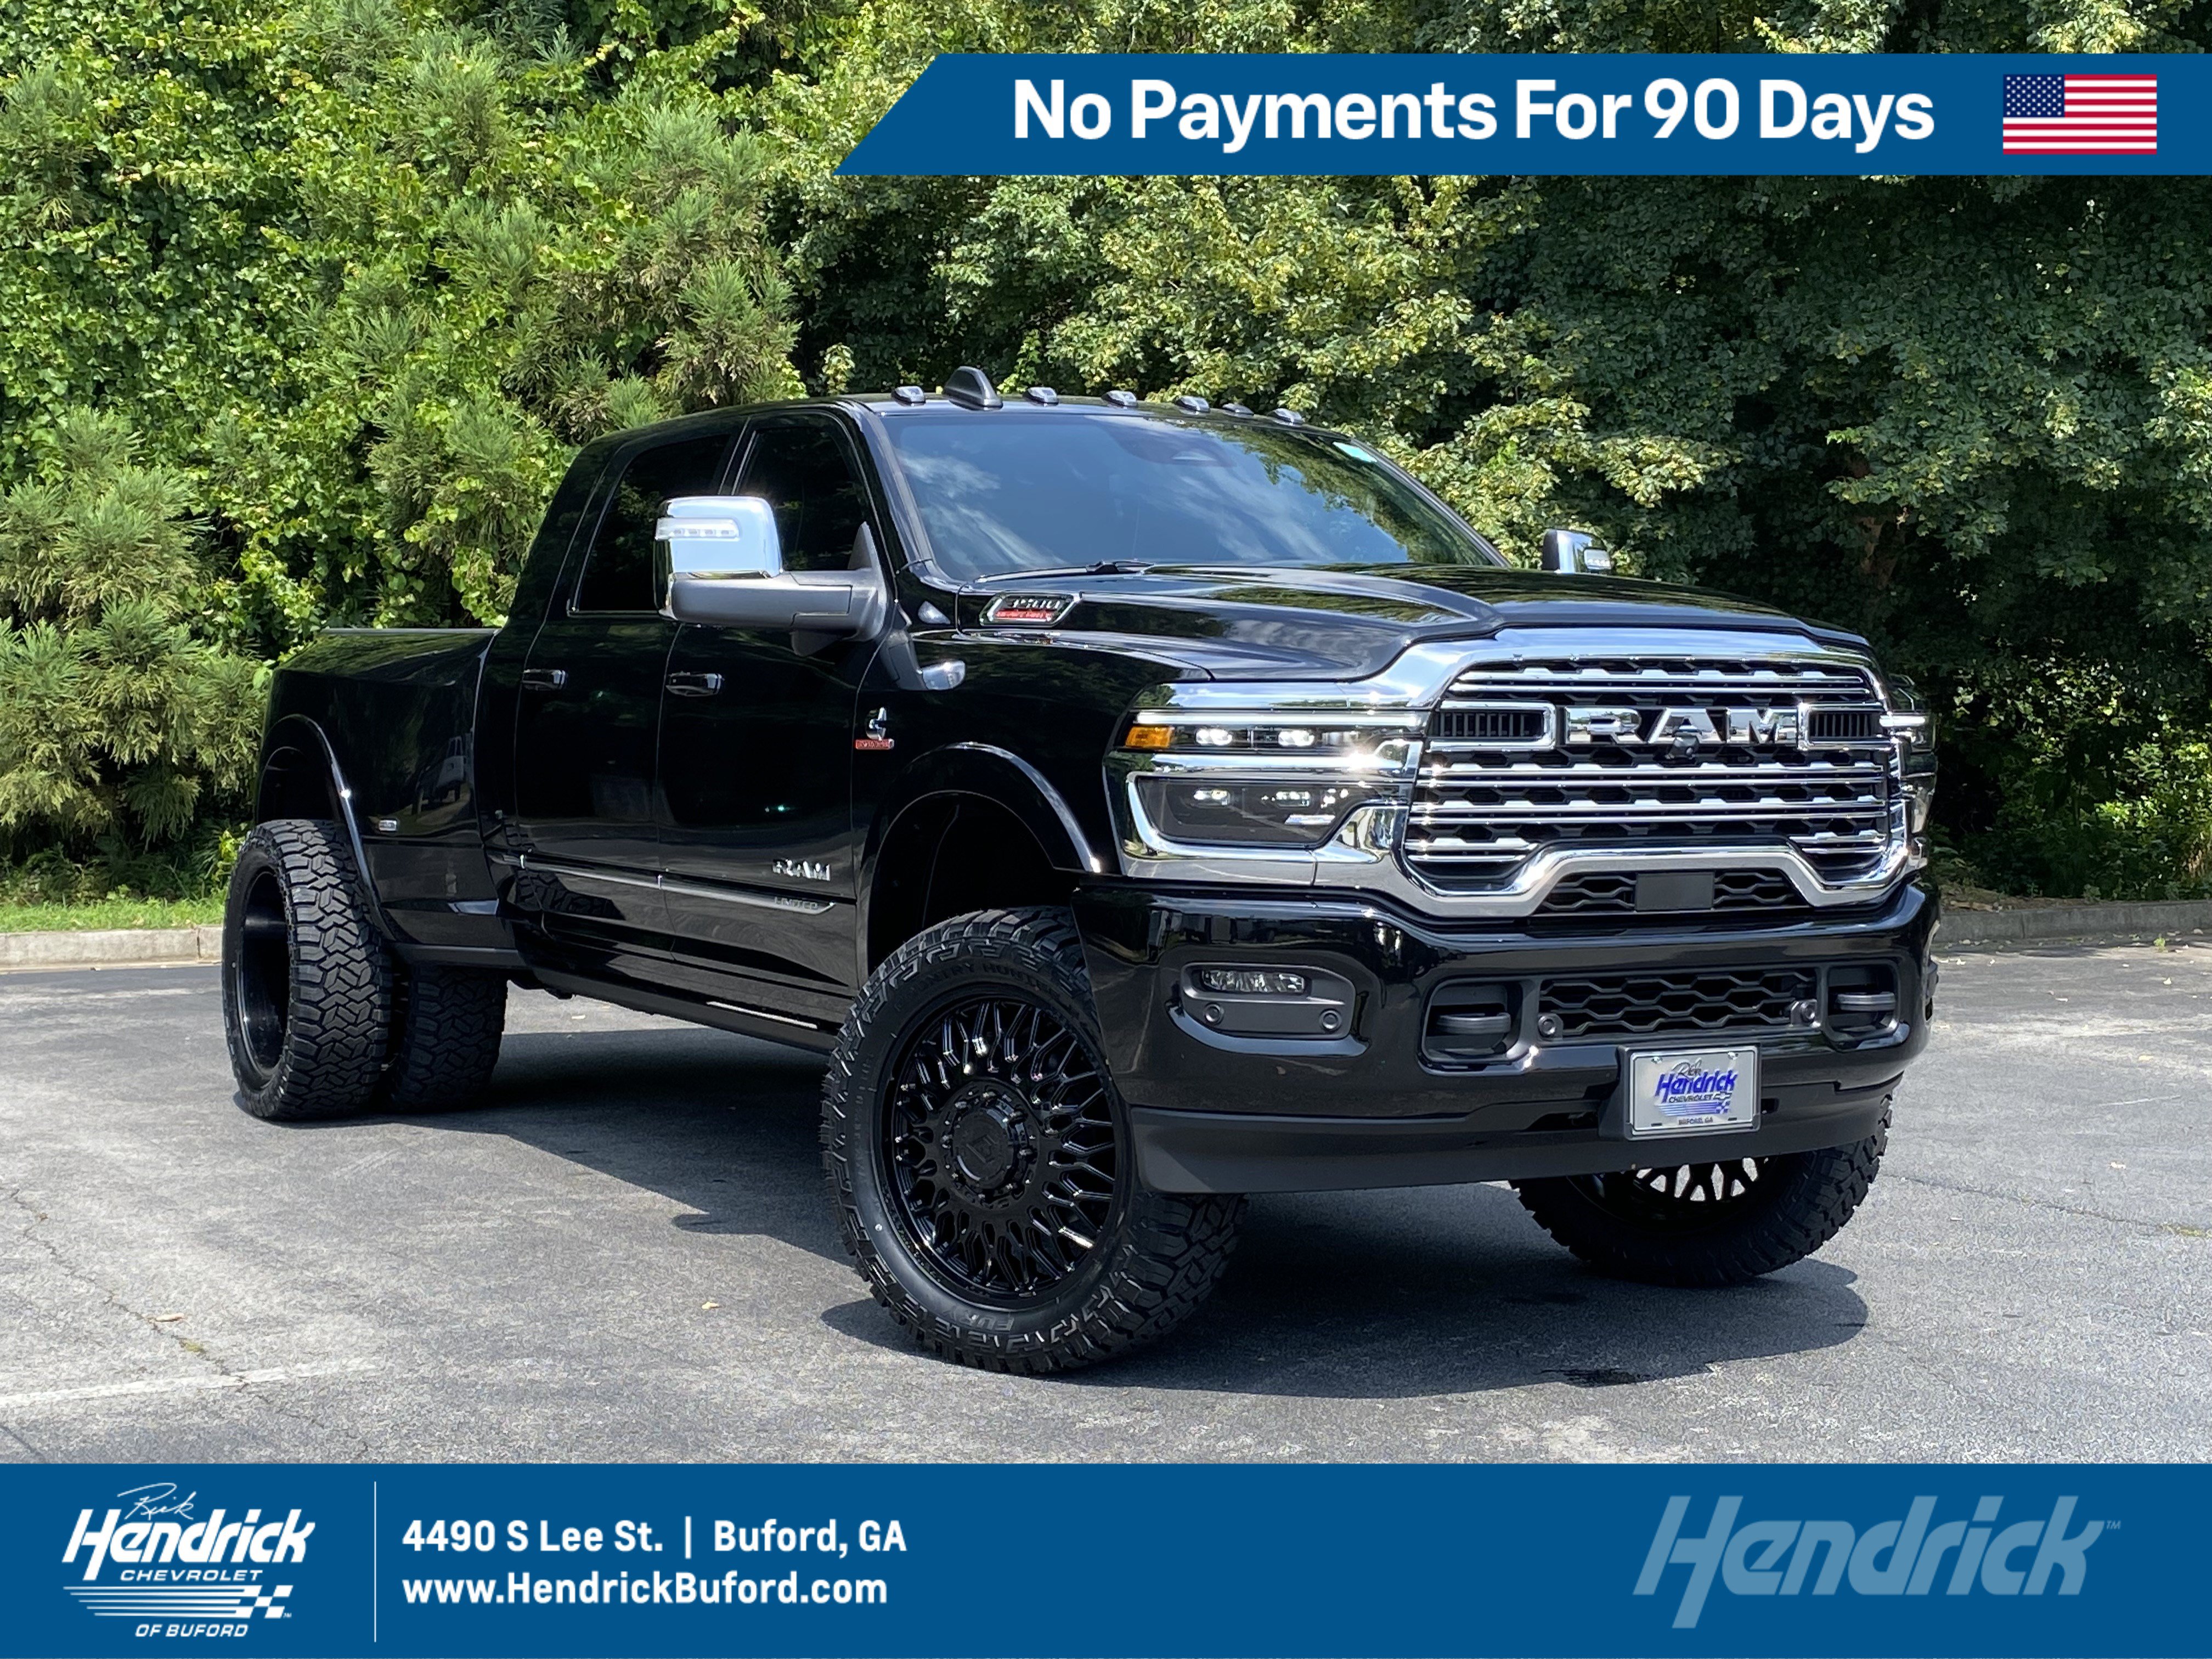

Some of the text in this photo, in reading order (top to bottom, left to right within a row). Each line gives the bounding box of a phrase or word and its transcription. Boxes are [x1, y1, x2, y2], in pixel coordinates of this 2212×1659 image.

[1565, 707, 1798, 744] RAM
[772, 859, 831, 881] RAM
[1655, 1070, 1739, 1103] Hendrick
